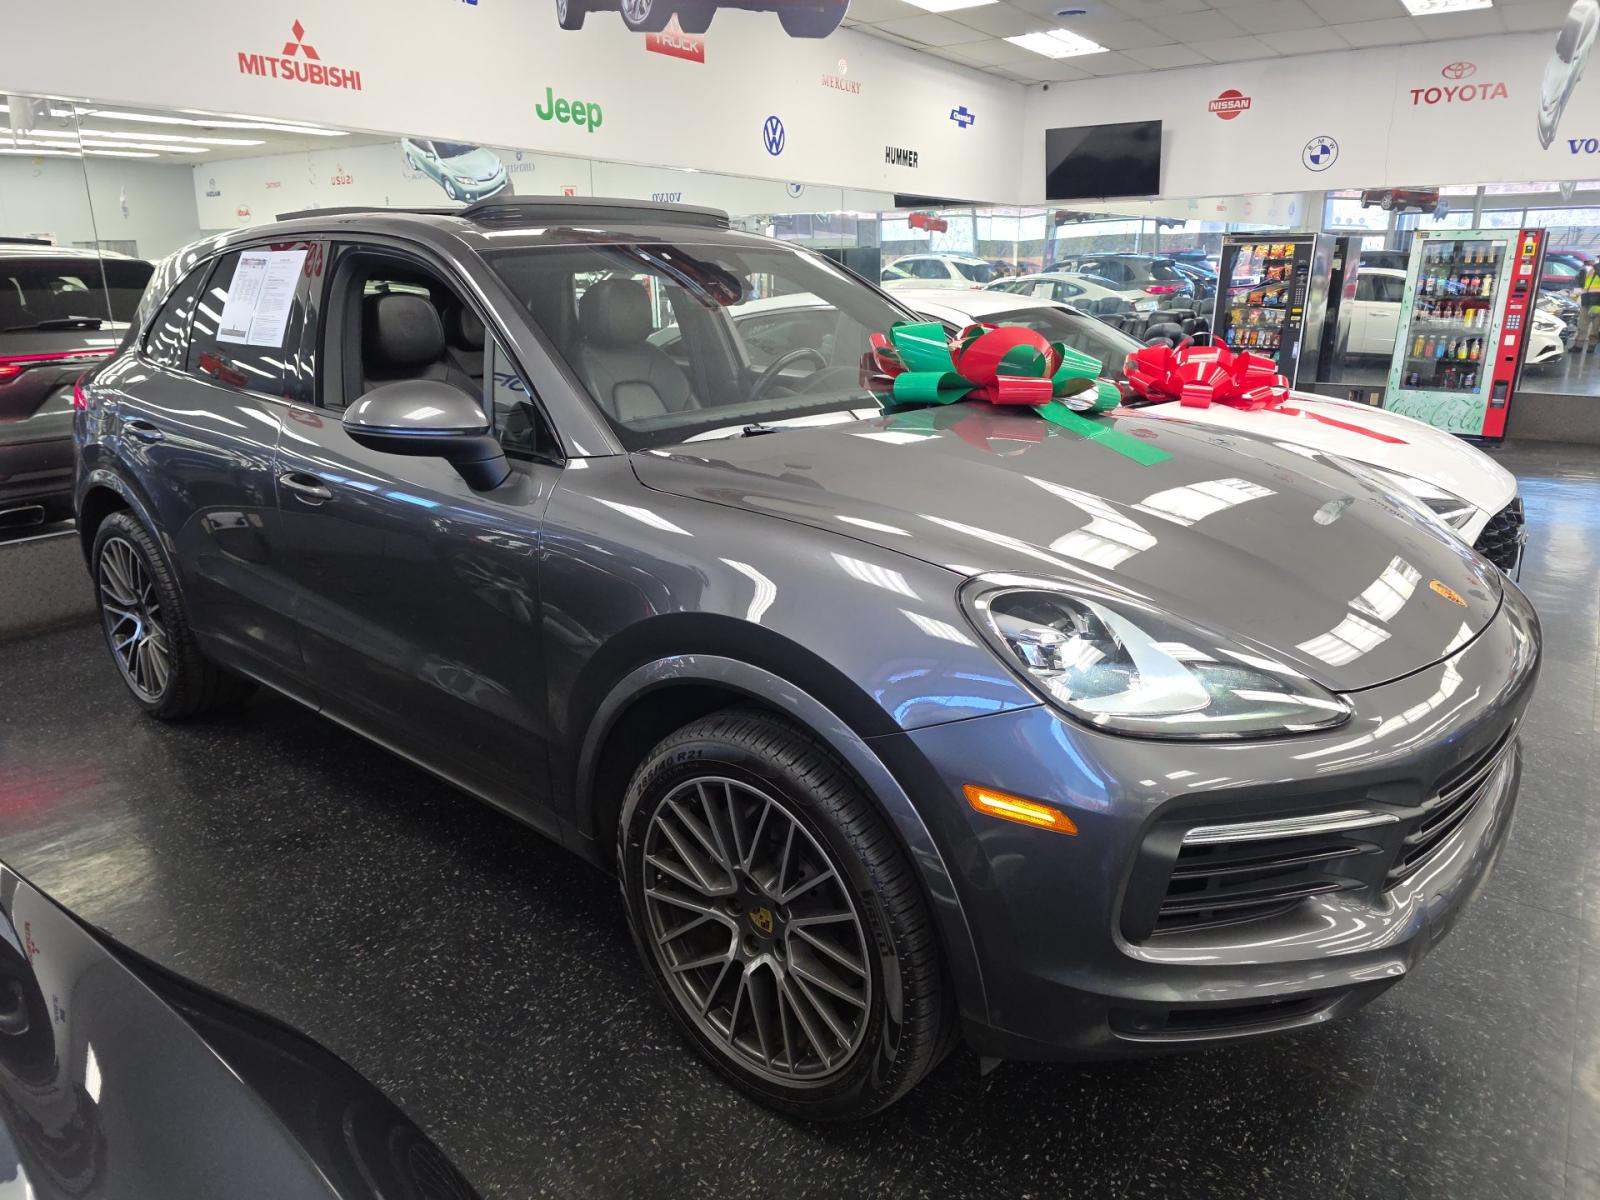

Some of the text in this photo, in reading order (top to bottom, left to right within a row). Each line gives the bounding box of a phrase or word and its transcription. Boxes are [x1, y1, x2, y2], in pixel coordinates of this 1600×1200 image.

[652, 34, 699, 54] TRUCK
[238, 52, 362, 91] MITSUBISHI
[821, 74, 862, 95] MERCURY
[1410, 82, 1509, 105] TOYOTA
[535, 87, 603, 133] Jeep
[1210, 99, 1249, 111] NISSAN
[1567, 138, 1600, 154] VO
[885, 146, 919, 168] HUMMER
[677, 750, 704, 762] R21
